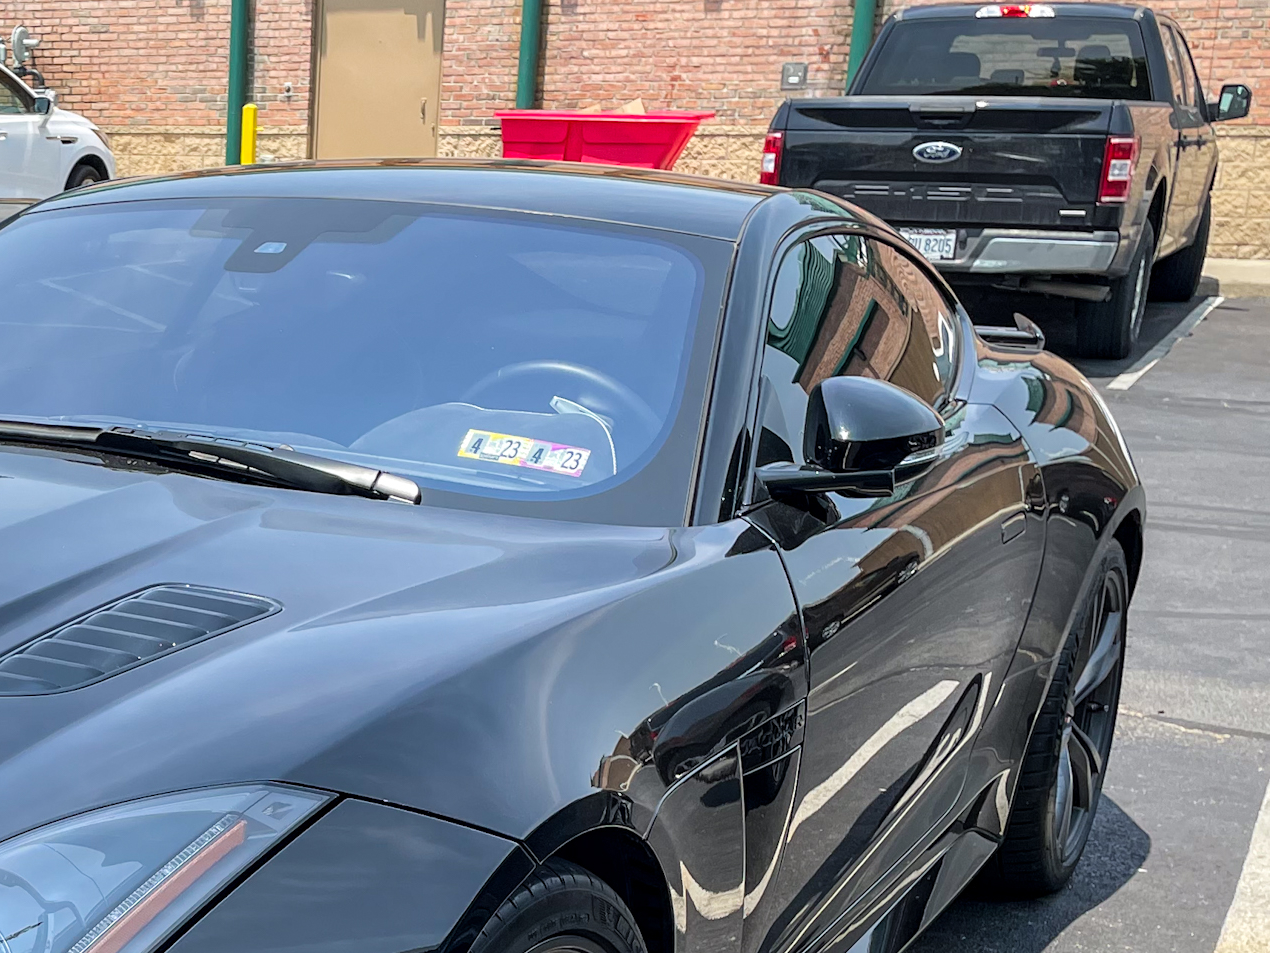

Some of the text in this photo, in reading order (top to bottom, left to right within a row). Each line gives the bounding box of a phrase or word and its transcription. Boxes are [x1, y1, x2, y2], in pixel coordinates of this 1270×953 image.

[924, 238, 952, 254] 8205
[469, 438, 484, 455] 4
[500, 440, 521, 459] 23
[531, 448, 582, 470] 4 23
